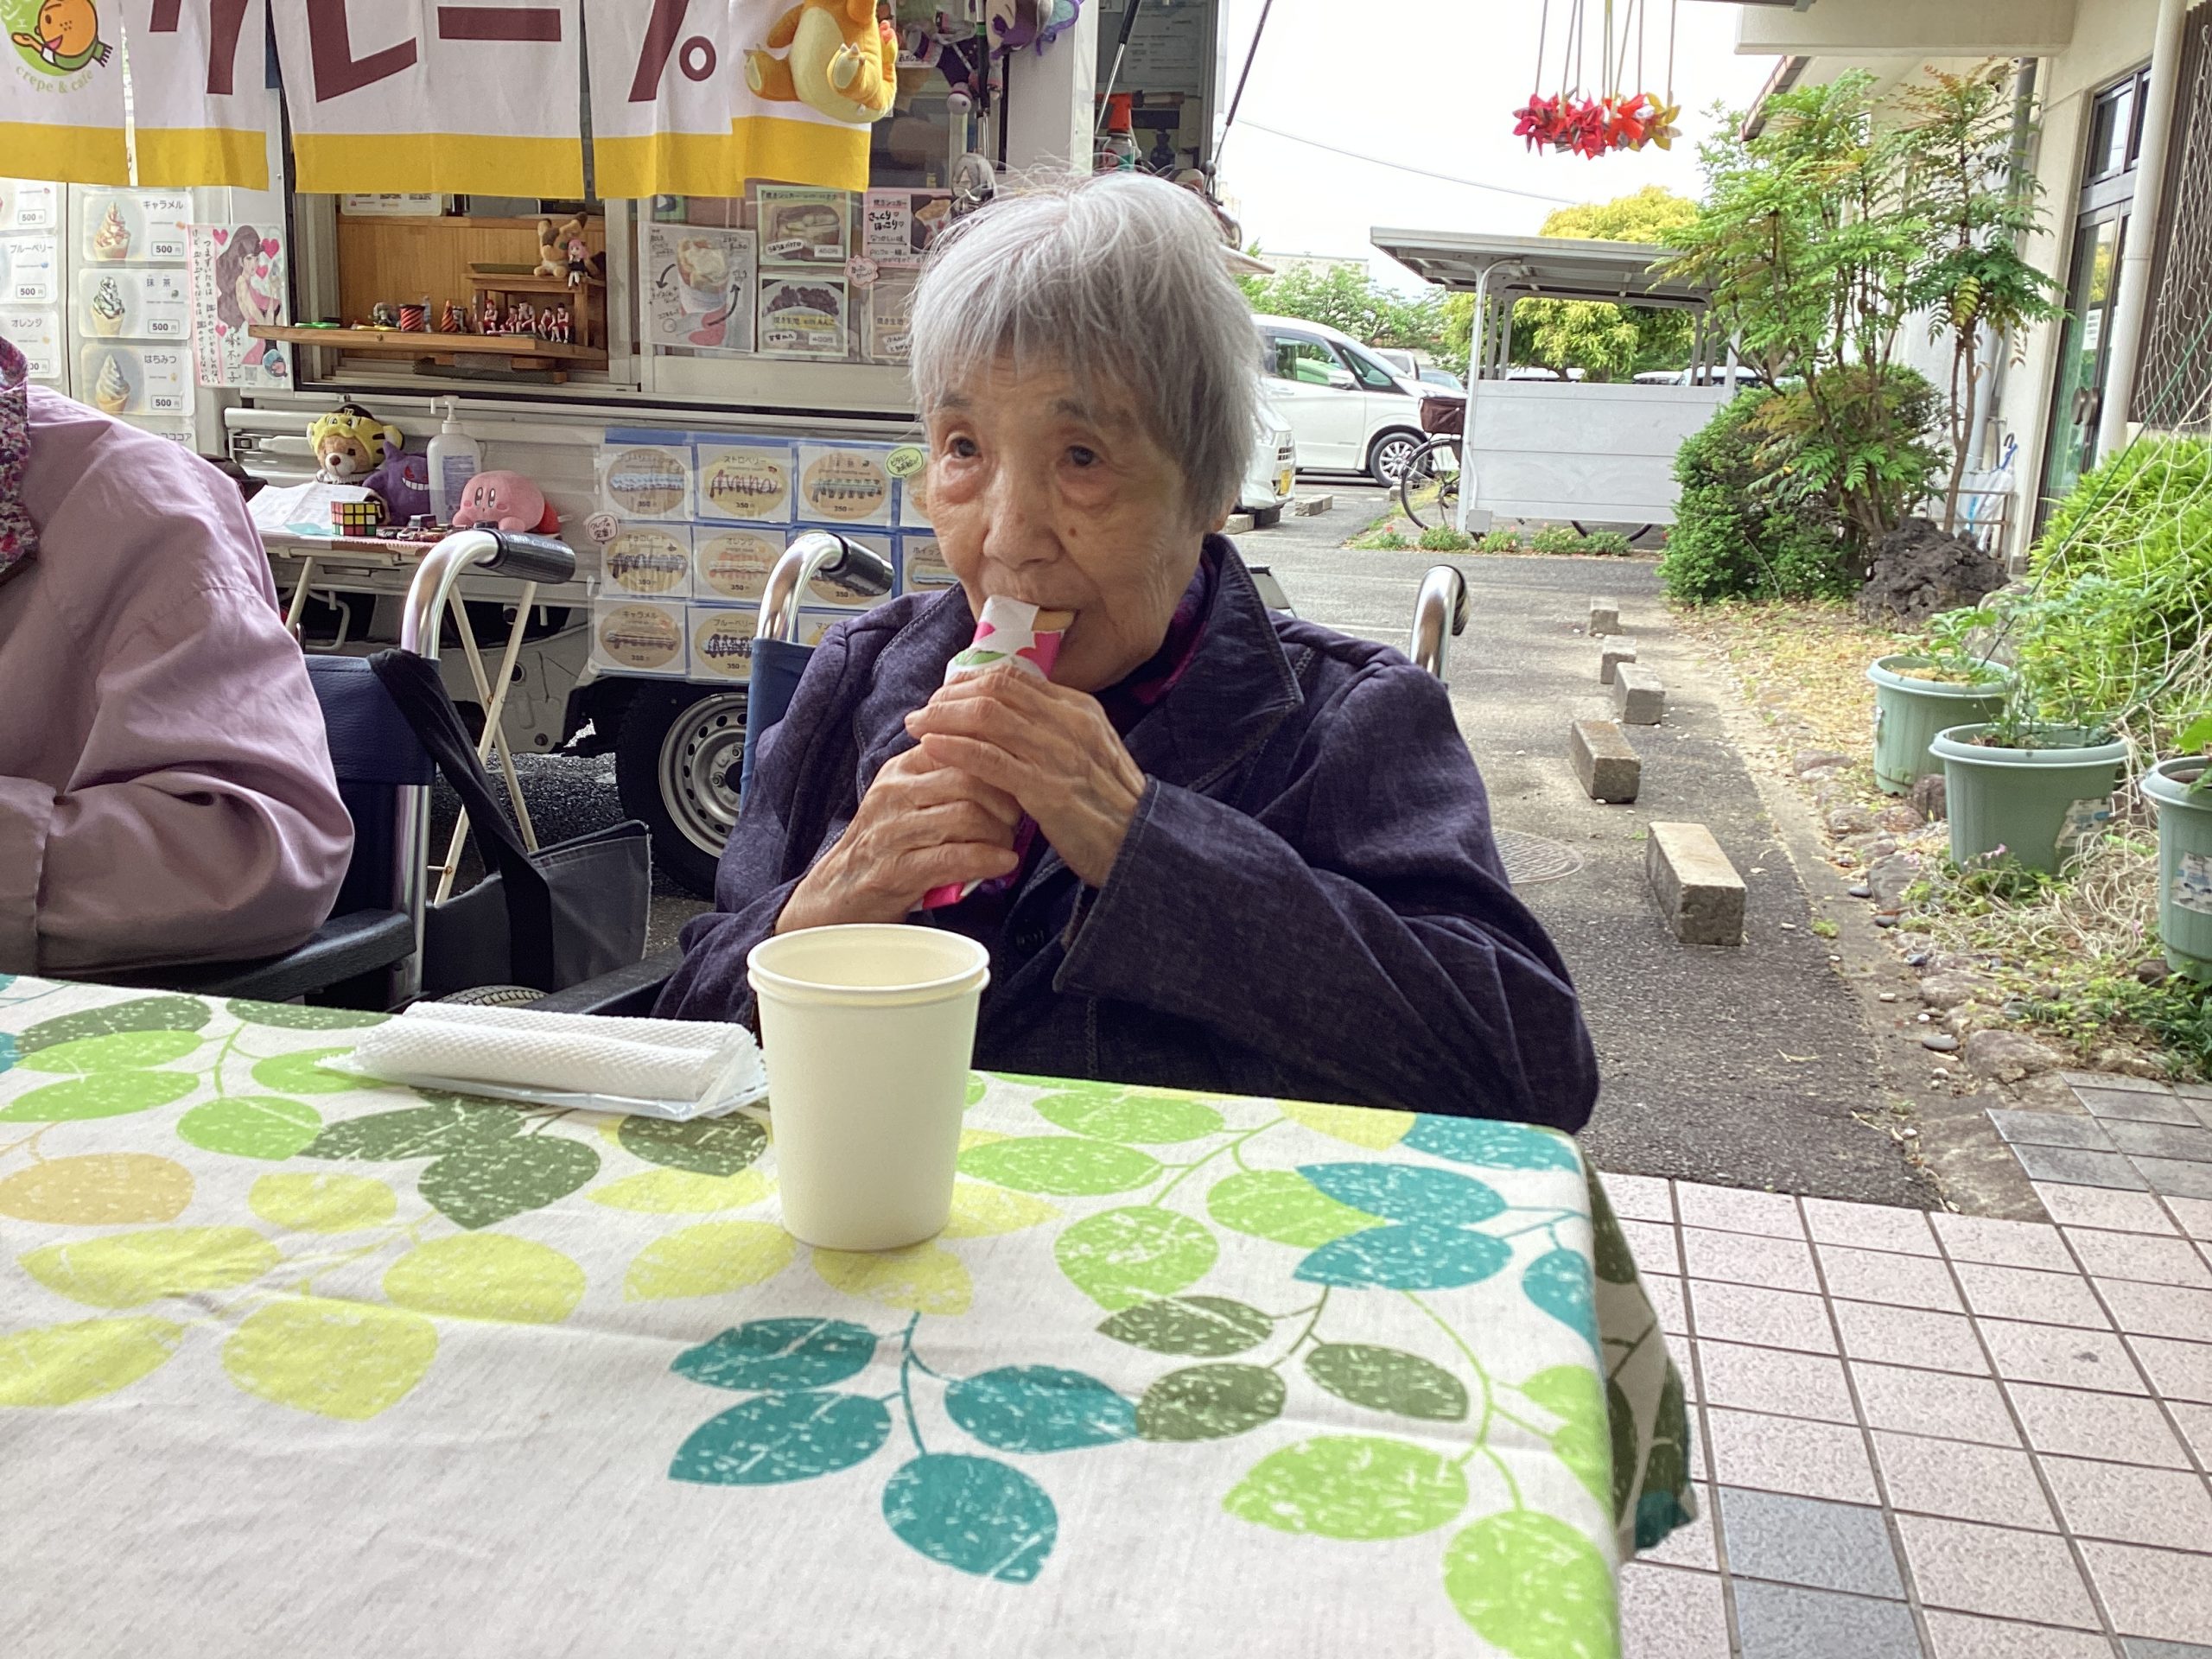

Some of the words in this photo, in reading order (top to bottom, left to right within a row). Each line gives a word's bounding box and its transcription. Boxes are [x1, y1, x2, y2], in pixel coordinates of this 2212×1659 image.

[16, 66, 54, 92] crepe
[59, 80, 68, 94] &
[143, 200, 184, 210] キャラメル
[868, 210, 892, 221] さっくり
[874, 219, 899, 231] ほっこり
[10, 242, 54, 253] ブルーベリー
[20, 287, 35, 296] 500
[11, 317, 42, 327] オレンジ
[152, 322, 168, 331] 500
[143, 354, 177, 365] はちみつ
[156, 398, 172, 407] 500
[724, 455, 766, 465] ストロベリー
[726, 537, 754, 546] オレンジ
[622, 611, 658, 620] キャラメル
